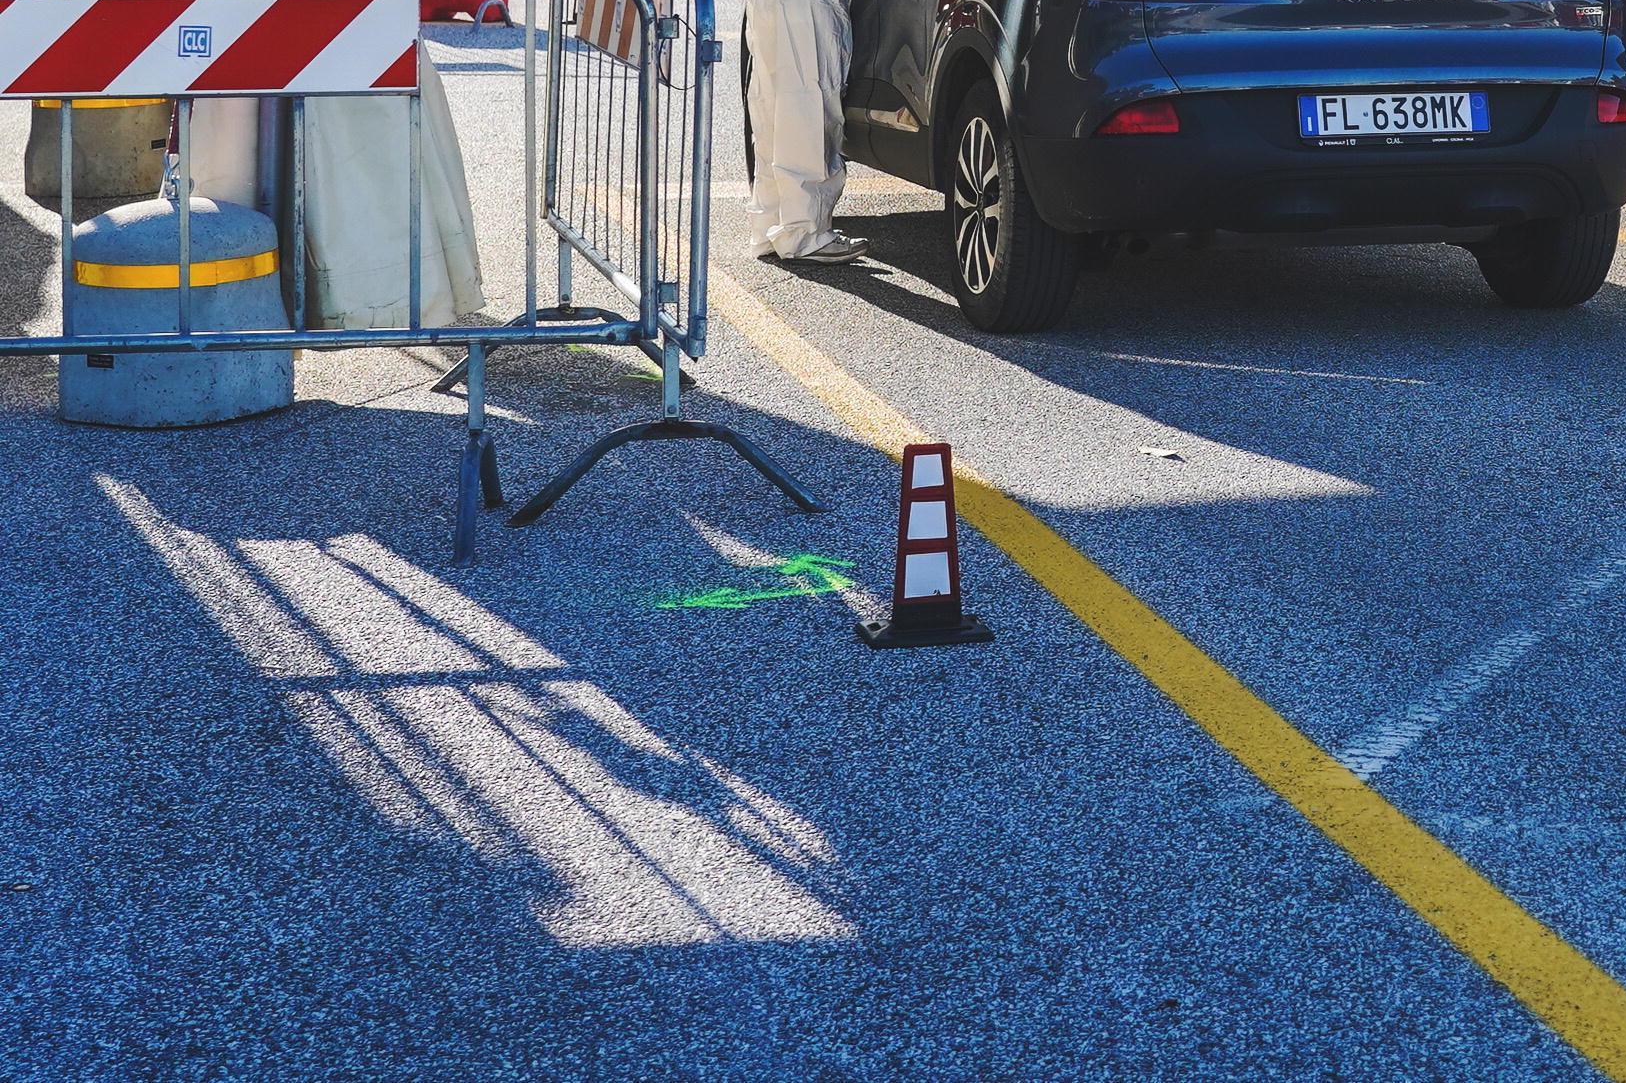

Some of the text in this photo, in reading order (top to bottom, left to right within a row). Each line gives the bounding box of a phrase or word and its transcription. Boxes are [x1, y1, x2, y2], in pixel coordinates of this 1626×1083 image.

[184, 32, 205, 51] CLC
[1321, 97, 1360, 131] FL
[1371, 95, 1468, 131] 638MK
